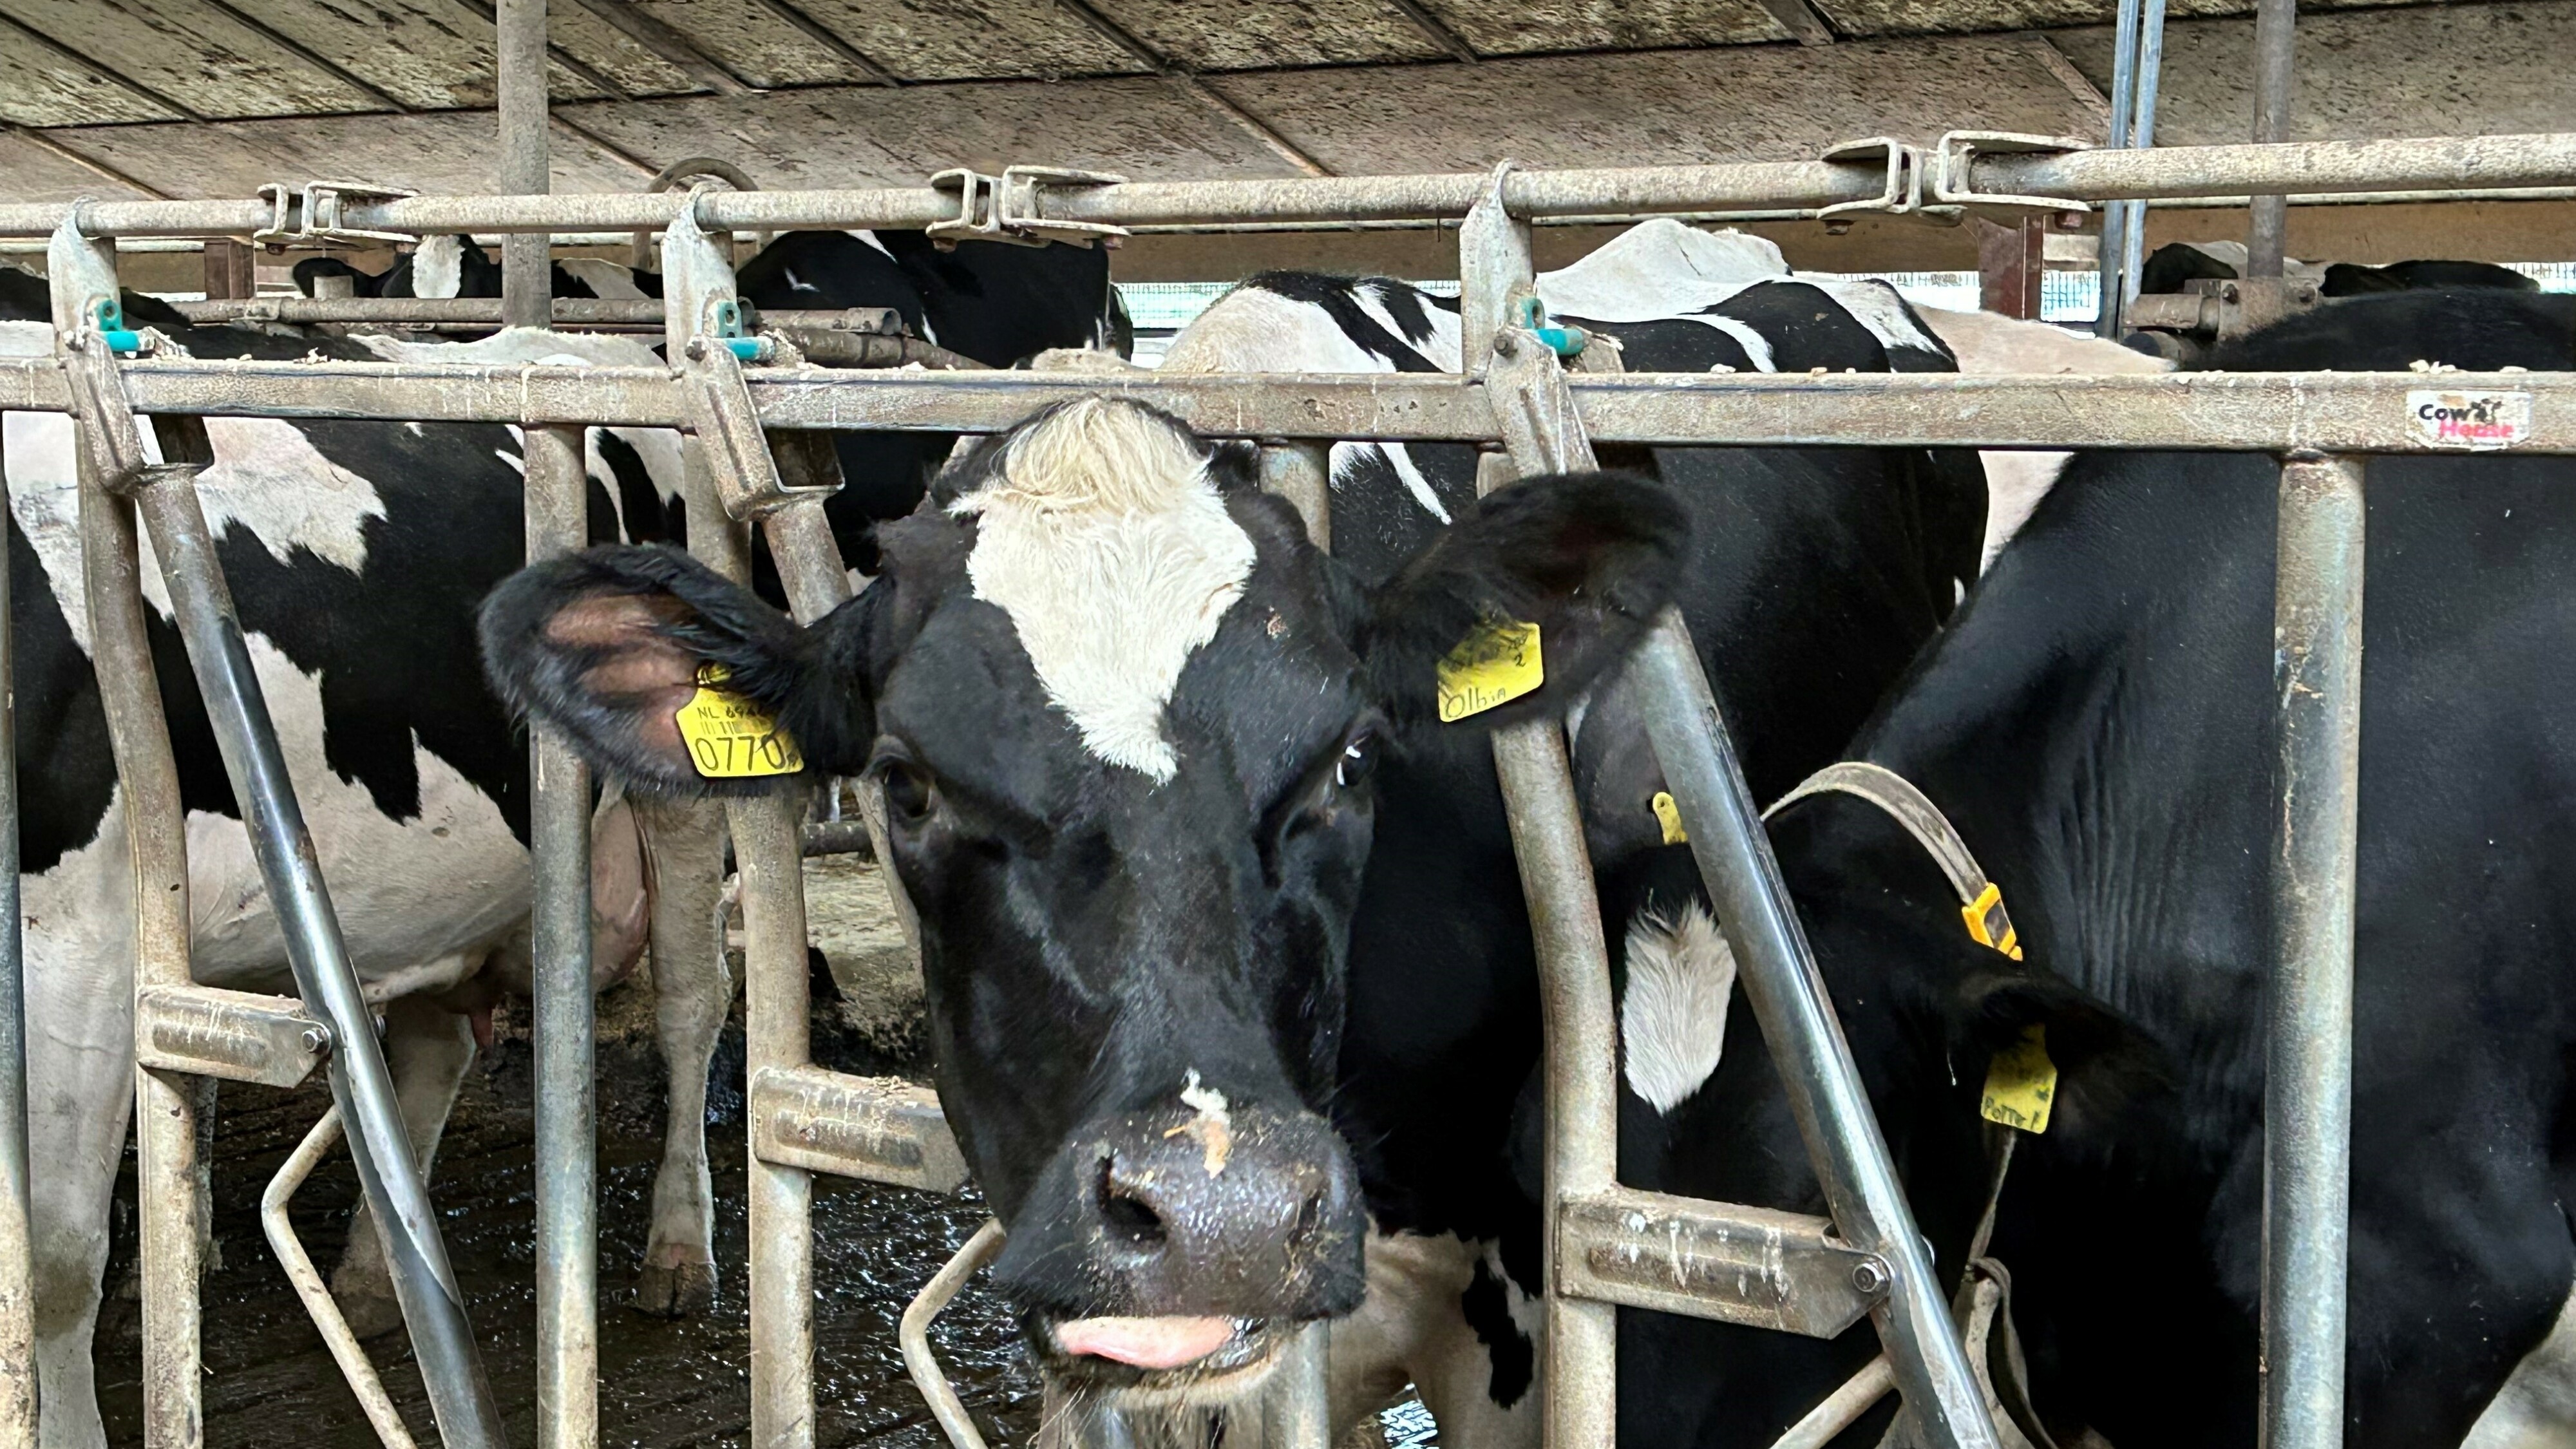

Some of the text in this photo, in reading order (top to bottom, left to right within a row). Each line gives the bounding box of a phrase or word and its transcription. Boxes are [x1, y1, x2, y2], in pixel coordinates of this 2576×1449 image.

[2419, 404, 2471, 421] Cow
[697, 706, 720, 719] NL
[695, 735, 786, 772] 0770
